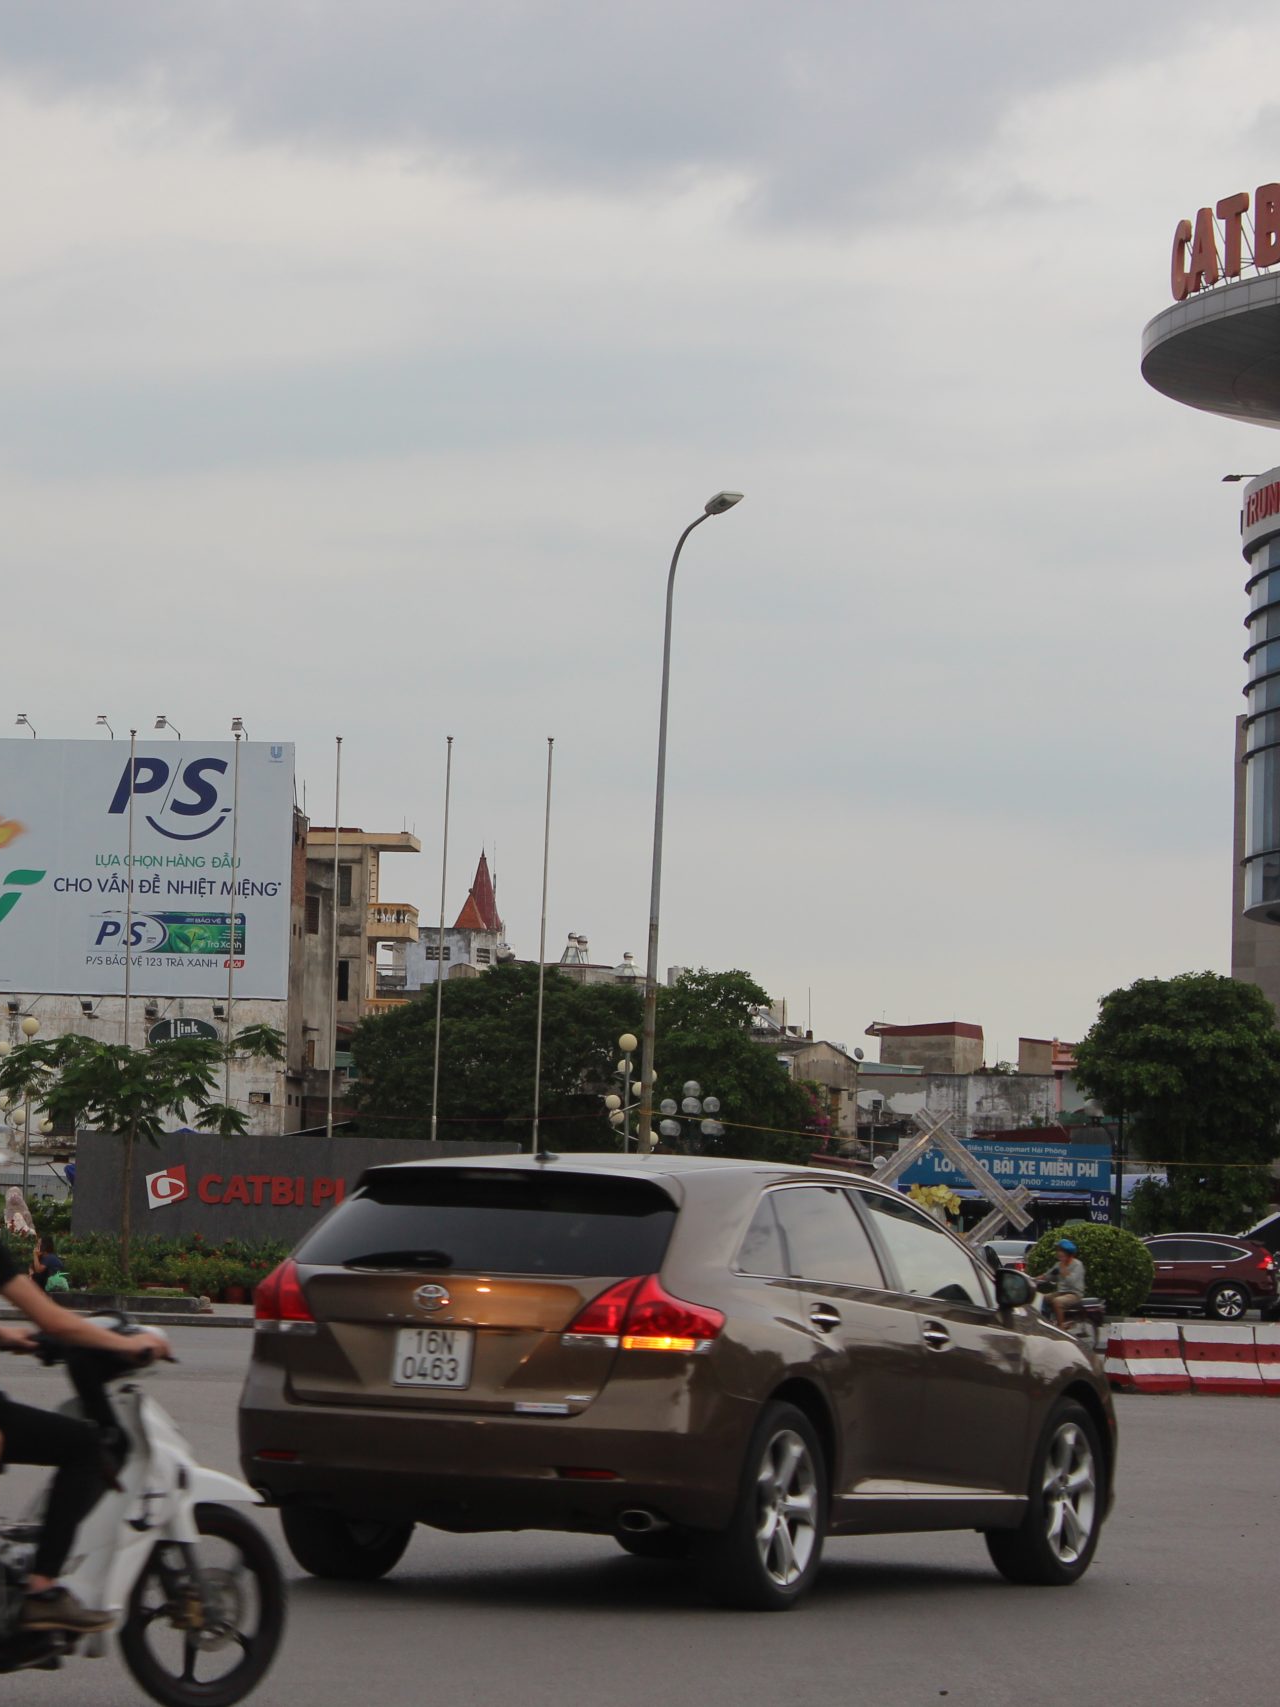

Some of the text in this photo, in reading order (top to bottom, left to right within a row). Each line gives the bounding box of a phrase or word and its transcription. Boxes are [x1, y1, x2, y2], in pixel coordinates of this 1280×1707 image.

[95, 852, 241, 870] LỰA CHỌN HÀNG ĐẦU
[53, 878, 92, 893] CHO
[97, 873, 134, 894] VẤN
[138, 873, 161, 894] ĐỀ
[167, 878, 216, 898] NHIỆT
[86, 955, 103, 966] P/S
[105, 954, 128, 966] BẢO
[130, 955, 143, 968] VỆ
[146, 957, 162, 967] 123
[166, 957, 184, 967] TRÀ
[187, 958, 218, 968] XANH
[1019, 1160, 1036, 1175] XE
[1077, 1159, 1099, 1177] PHÍ
[198, 1175, 305, 1206] CATBI
[416, 1330, 454, 1355] 16N
[401, 1356, 459, 1381] 0463
